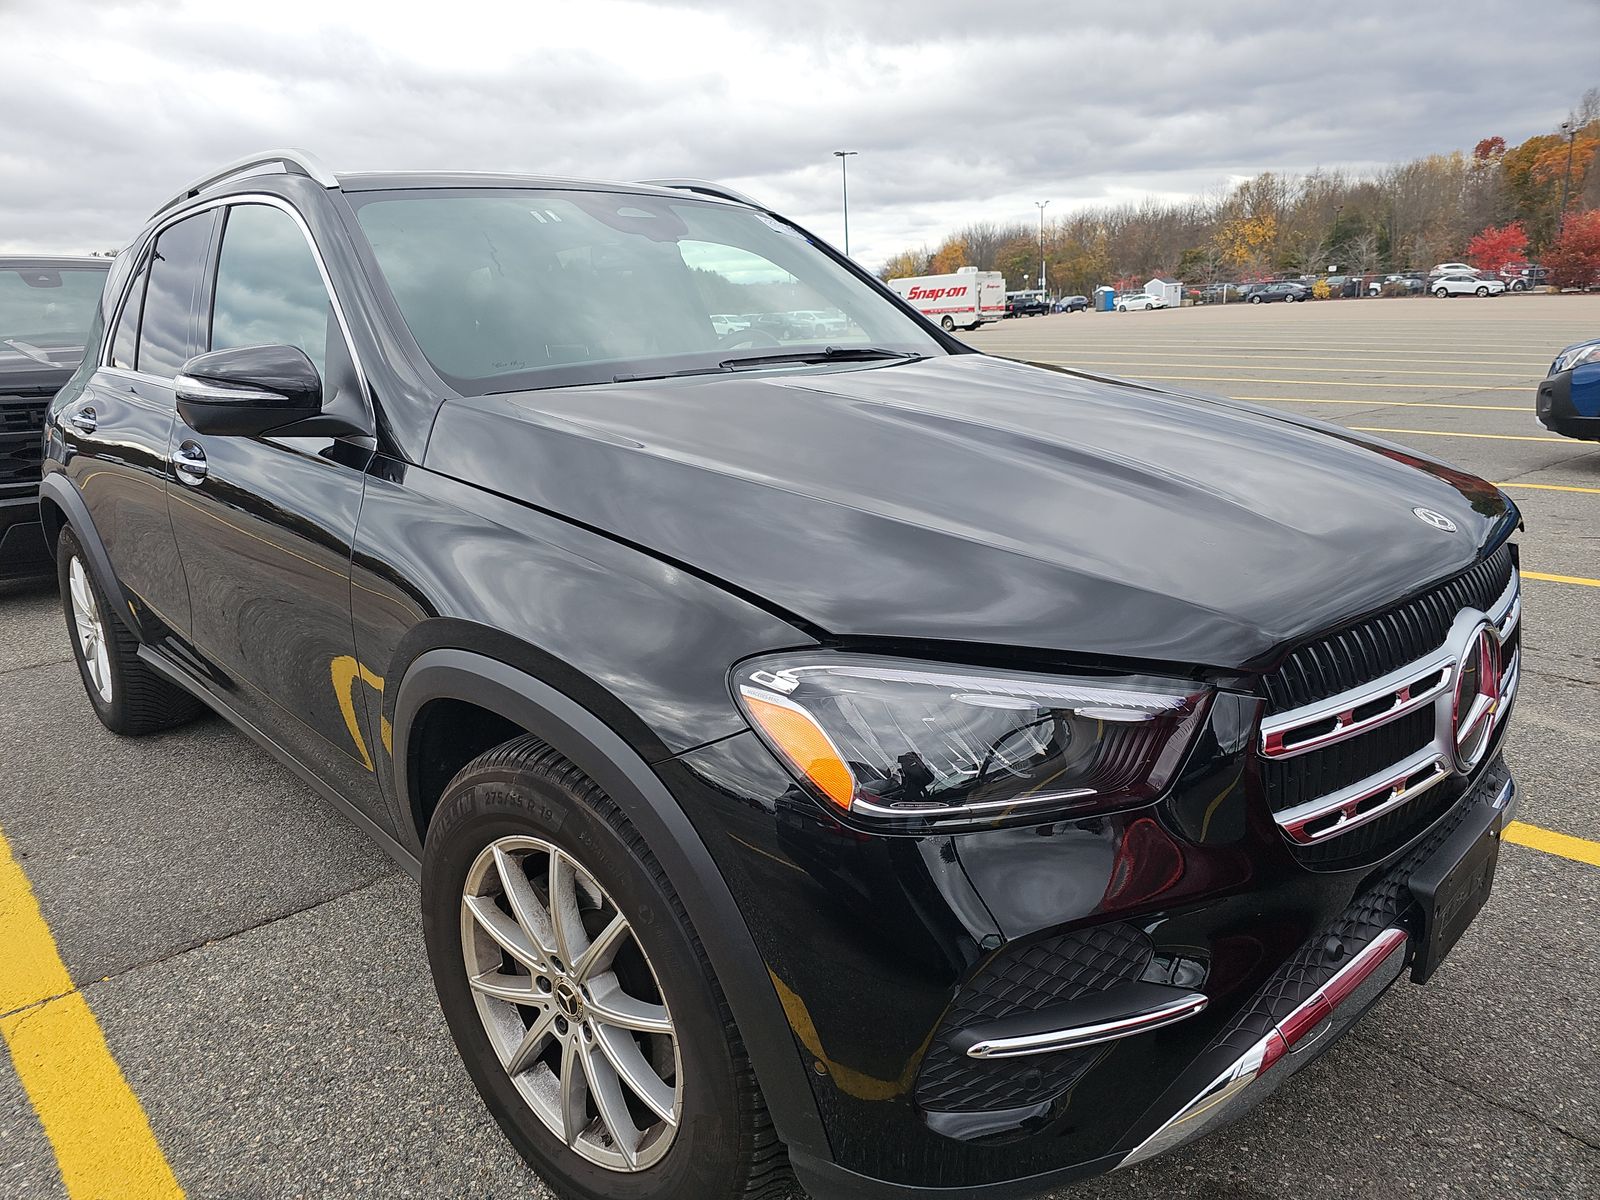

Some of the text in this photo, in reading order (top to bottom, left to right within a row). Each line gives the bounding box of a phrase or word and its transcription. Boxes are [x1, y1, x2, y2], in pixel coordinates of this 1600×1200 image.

[907, 286, 967, 301] Snap-on
[527, 800, 536, 813] R
[540, 805, 553, 822] 19
